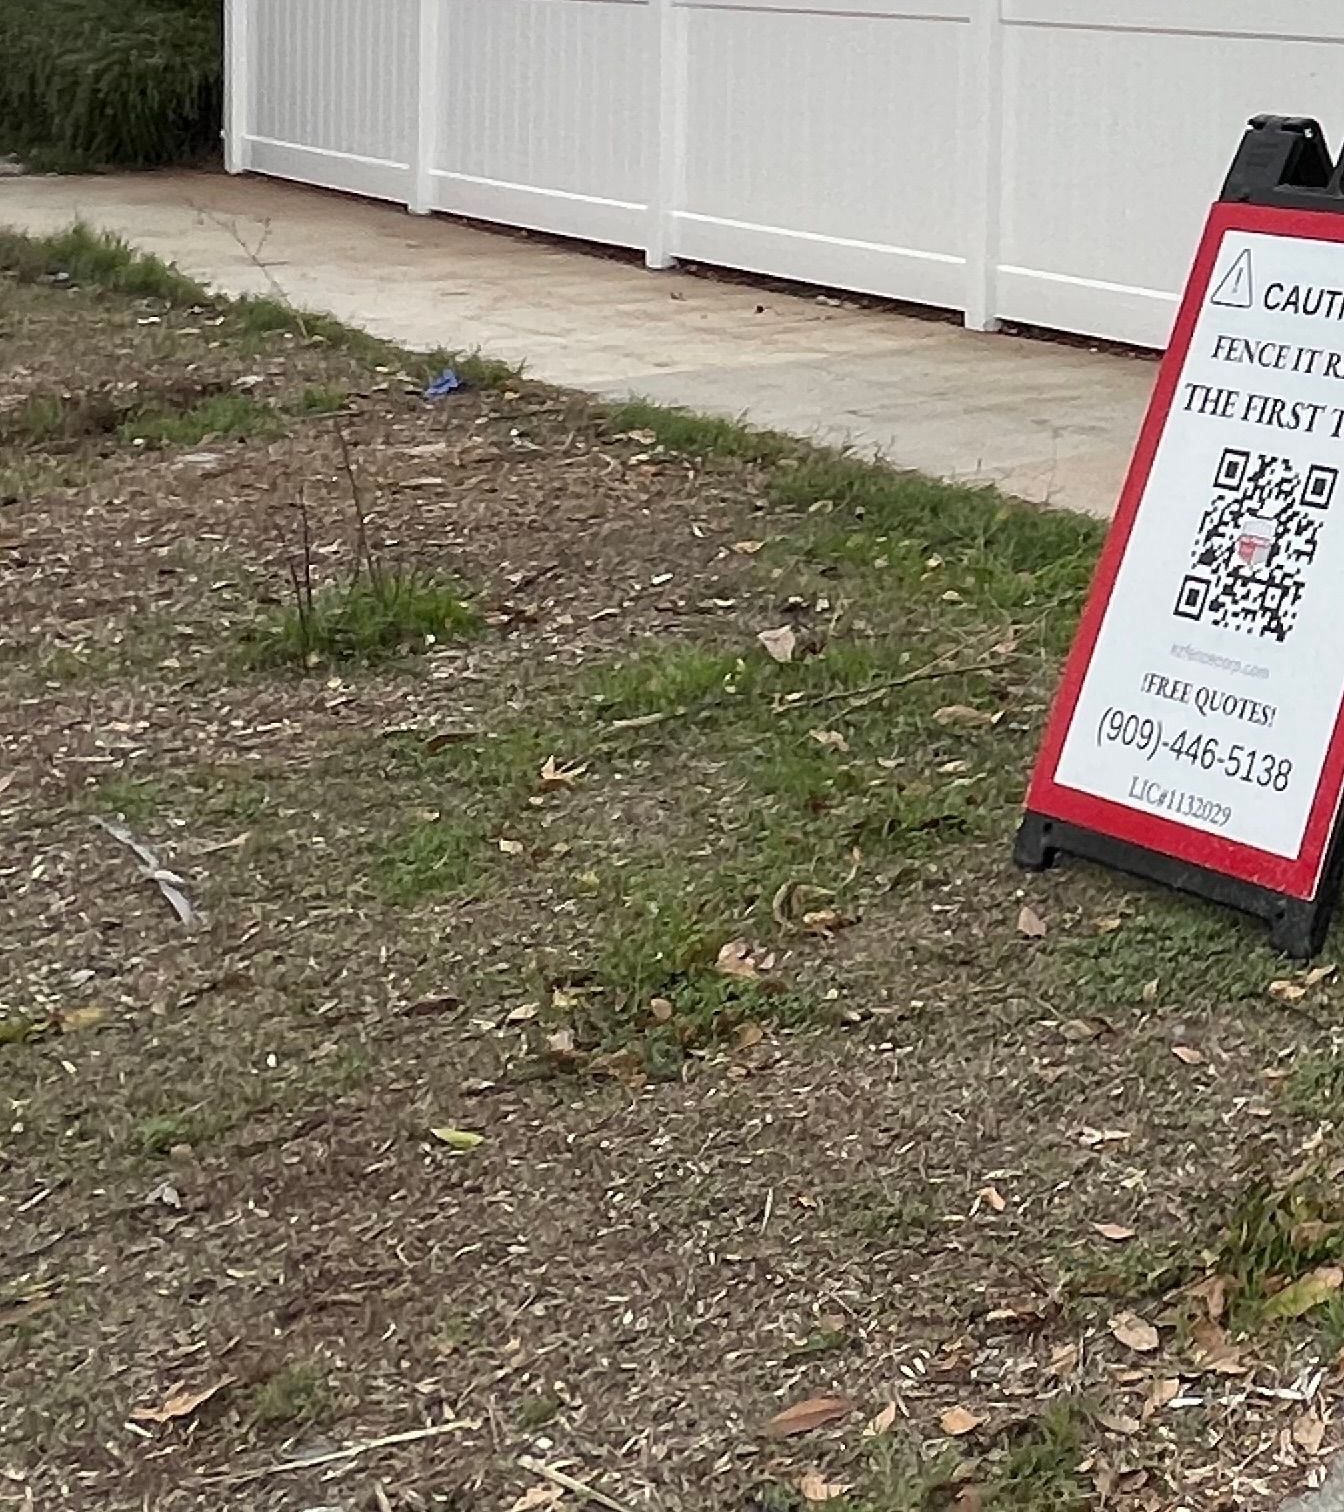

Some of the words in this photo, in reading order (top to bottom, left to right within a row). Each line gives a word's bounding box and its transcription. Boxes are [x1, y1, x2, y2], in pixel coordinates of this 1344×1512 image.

[1211, 335, 1290, 369] FENCE
[1291, 347, 1323, 374] IT
[1184, 382, 1240, 418] THE
[1241, 393, 1327, 433] FIRST
[1194, 686, 1278, 728] QUOTES!
[1097, 706, 1293, 792] (909)-446-5138
[1128, 775, 1232, 828] LIC#1132029
